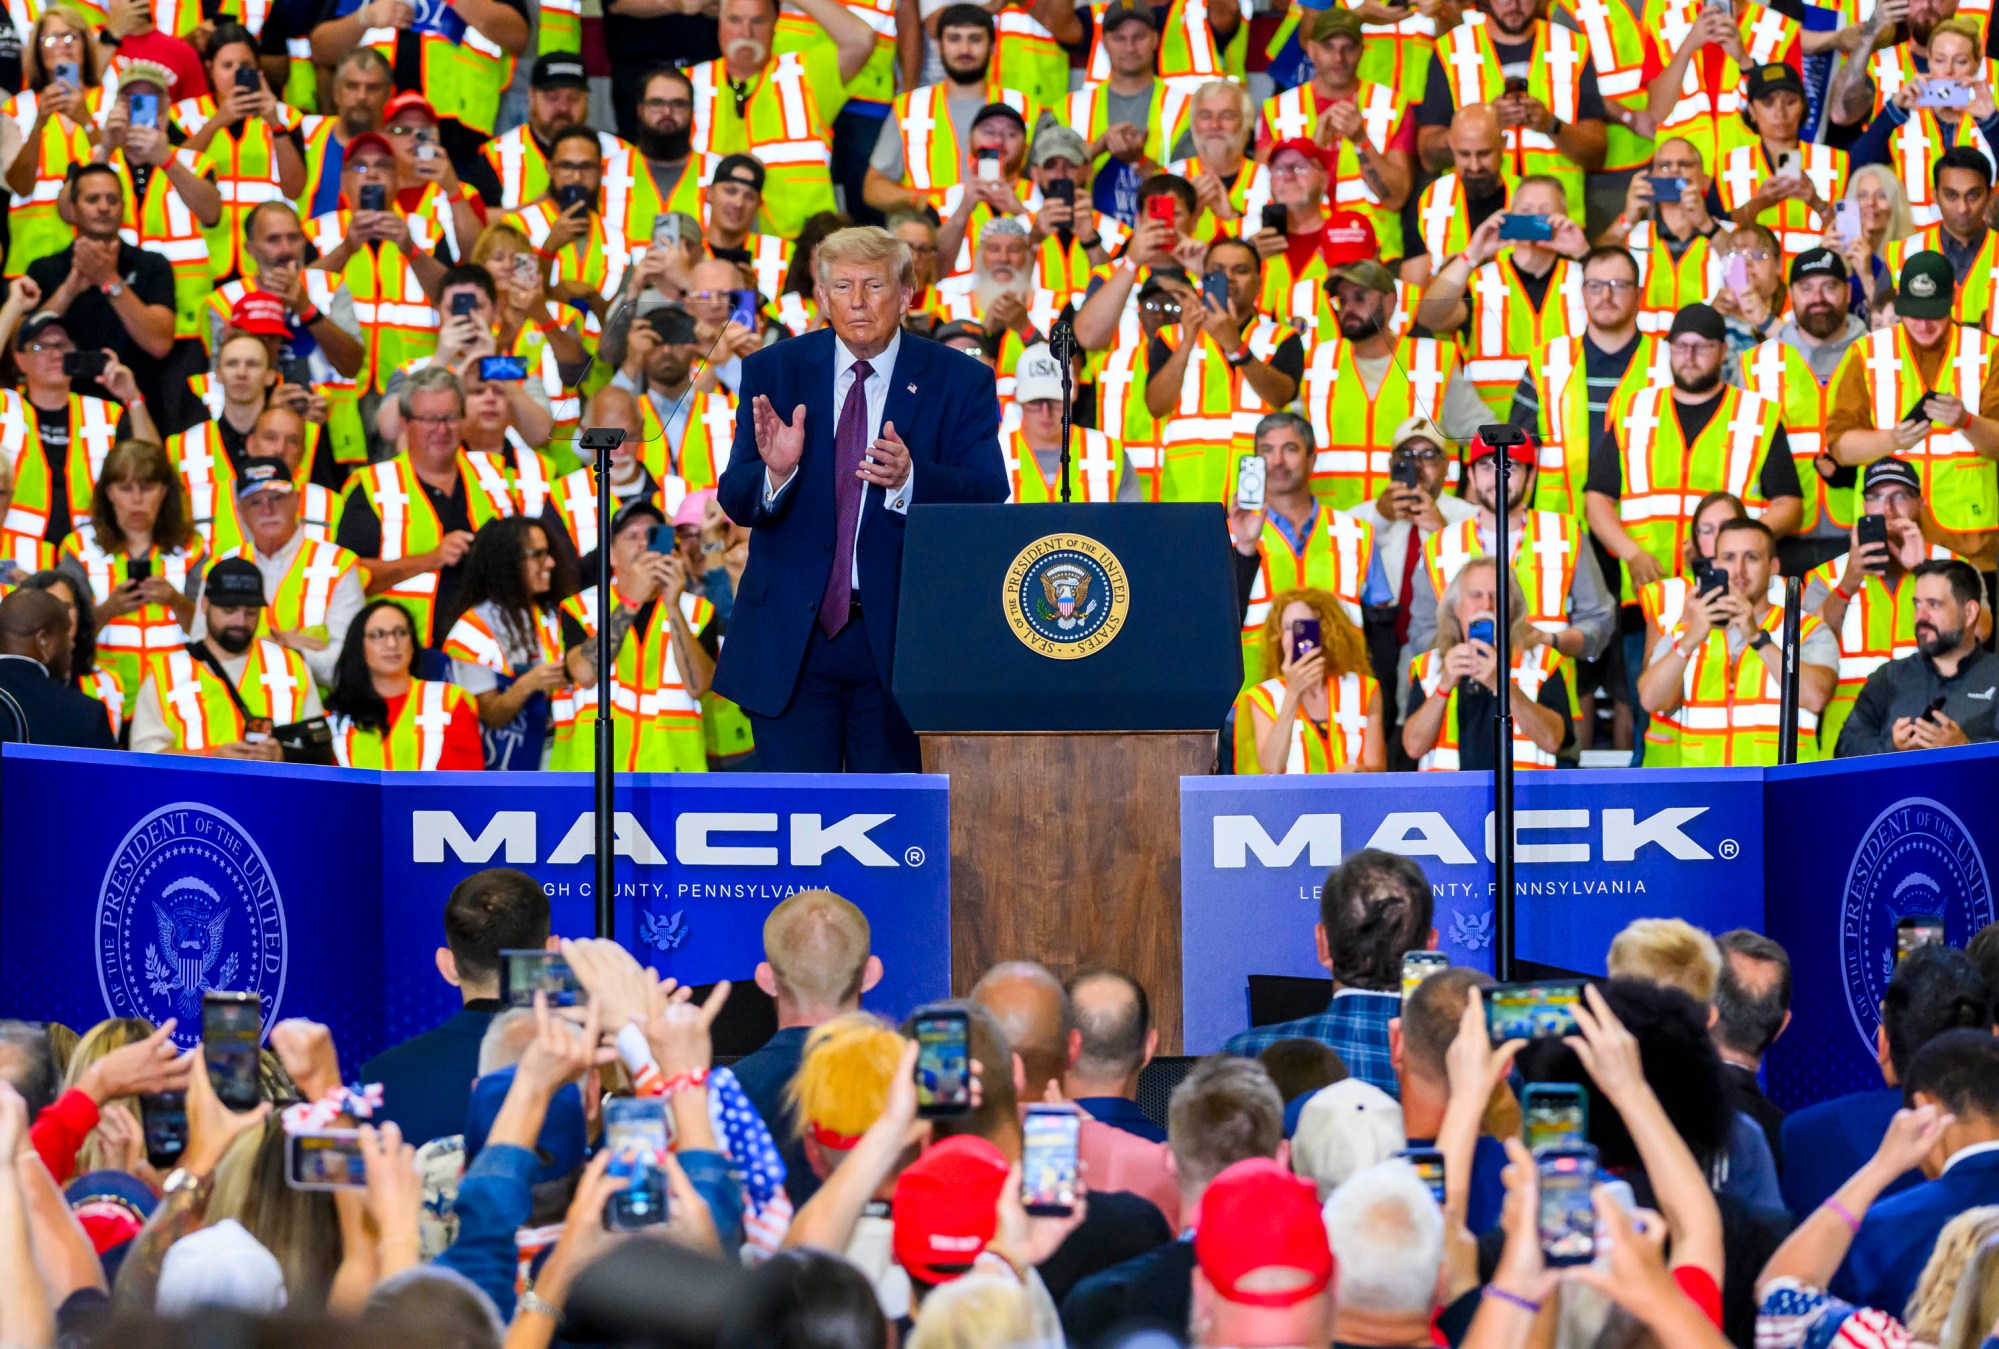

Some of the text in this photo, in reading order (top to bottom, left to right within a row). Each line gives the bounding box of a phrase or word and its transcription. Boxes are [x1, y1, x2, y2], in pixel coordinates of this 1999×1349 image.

[1028, 359, 1058, 378] USA
[1007, 537, 1126, 654] SEAL OF THE PRESIDENT OF THE UNITED STATES
[195, 817, 214, 834] OF
[216, 825, 242, 856] THE
[412, 810, 901, 867] MACK
[1213, 807, 1715, 868] MACK
[102, 812, 189, 930] PRESIDENT
[579, 882, 669, 899] CUNTY,
[1433, 880, 1647, 899] NTY, PNNSYLVANIA
[1845, 808, 1911, 938] PRESIDENT
[1916, 811, 1931, 827] OF
[1934, 815, 1955, 842] THE
[1956, 837, 1990, 930] UNITE
[243, 851, 281, 974] UNITED
[104, 938, 118, 978] THE
[111, 985, 126, 1007] OF
